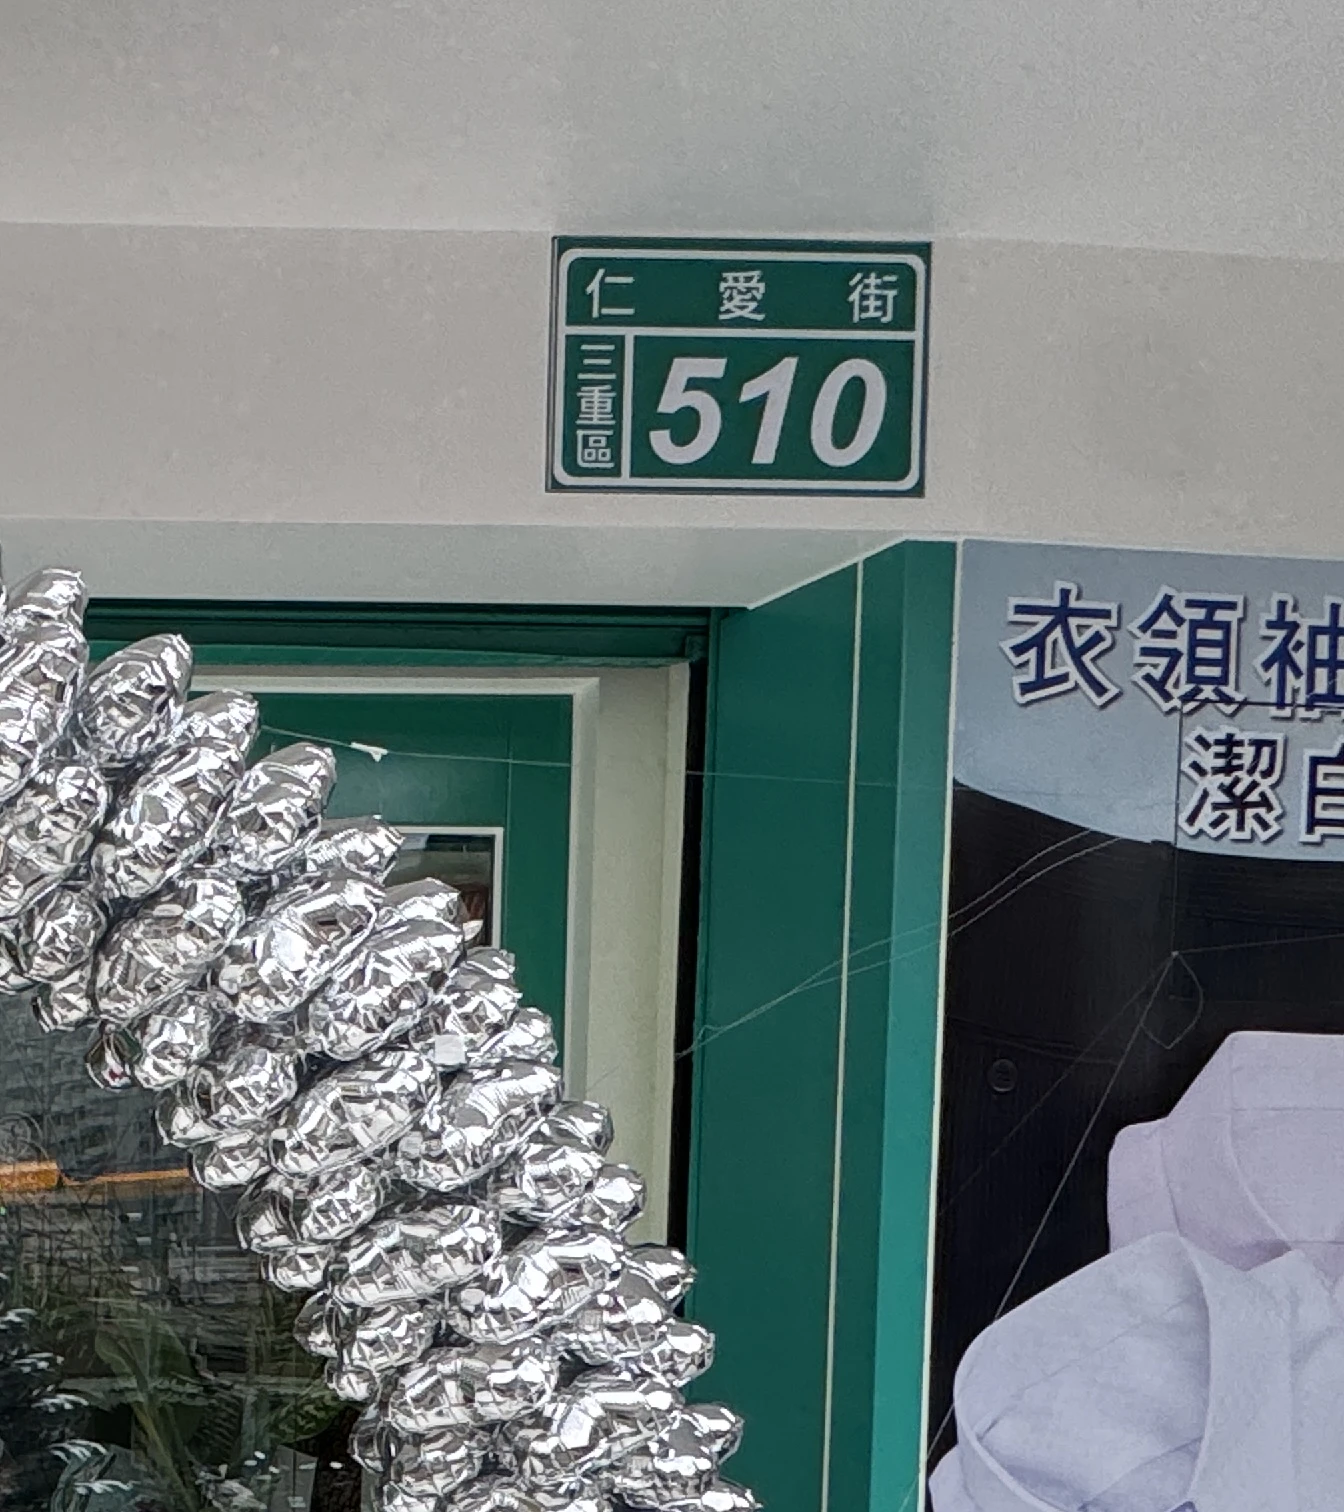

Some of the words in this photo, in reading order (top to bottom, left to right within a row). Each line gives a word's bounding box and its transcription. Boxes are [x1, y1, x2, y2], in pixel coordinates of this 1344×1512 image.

[585, 267, 899, 324] 仁愛街
[575, 343, 617, 469] 三重區
[648, 355, 888, 468] 510
[1002, 582, 1344, 716] 衣領袖
